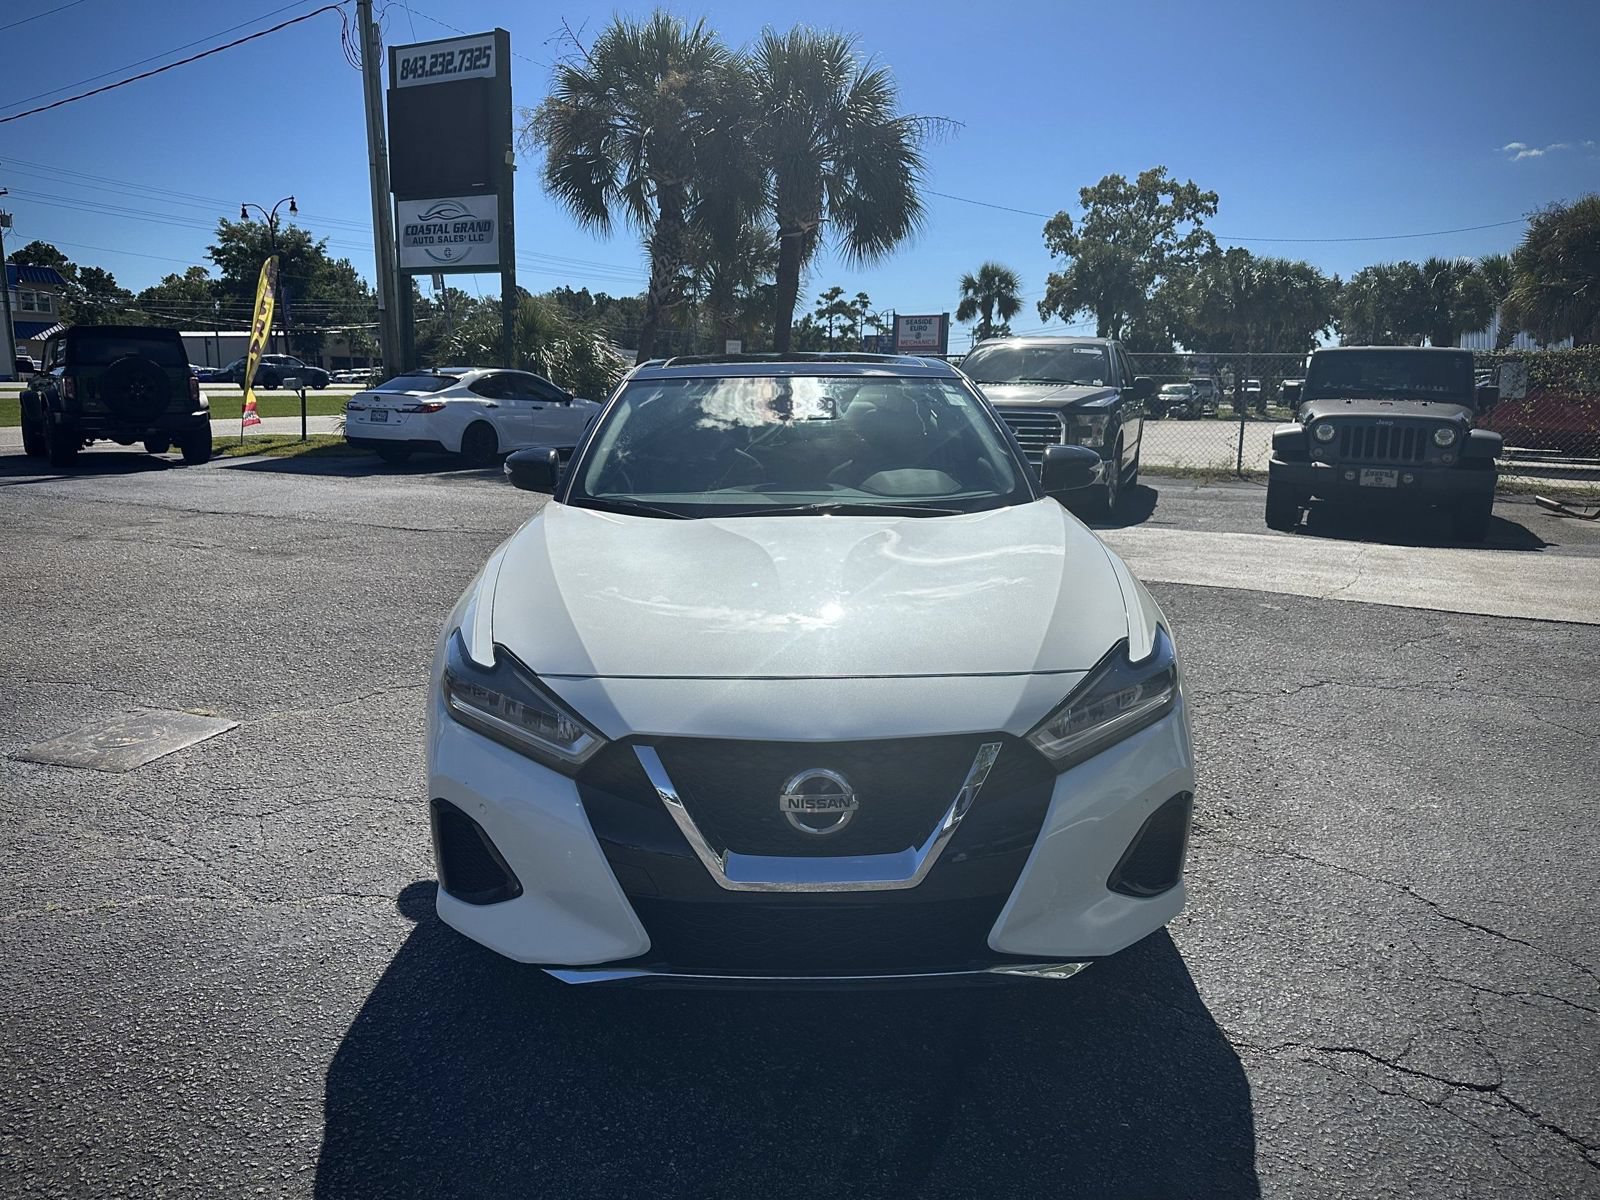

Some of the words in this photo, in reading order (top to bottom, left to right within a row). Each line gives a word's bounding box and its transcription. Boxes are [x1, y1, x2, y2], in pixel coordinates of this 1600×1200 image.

[400, 45, 492, 80] 843.232.7325
[405, 223, 450, 236] COASTAL
[453, 221, 491, 234] GRAND
[412, 236, 434, 245] AUTO
[468, 233, 484, 242] LLC
[905, 318, 933, 326] SEASIDE
[788, 798, 850, 809] NISSAN
